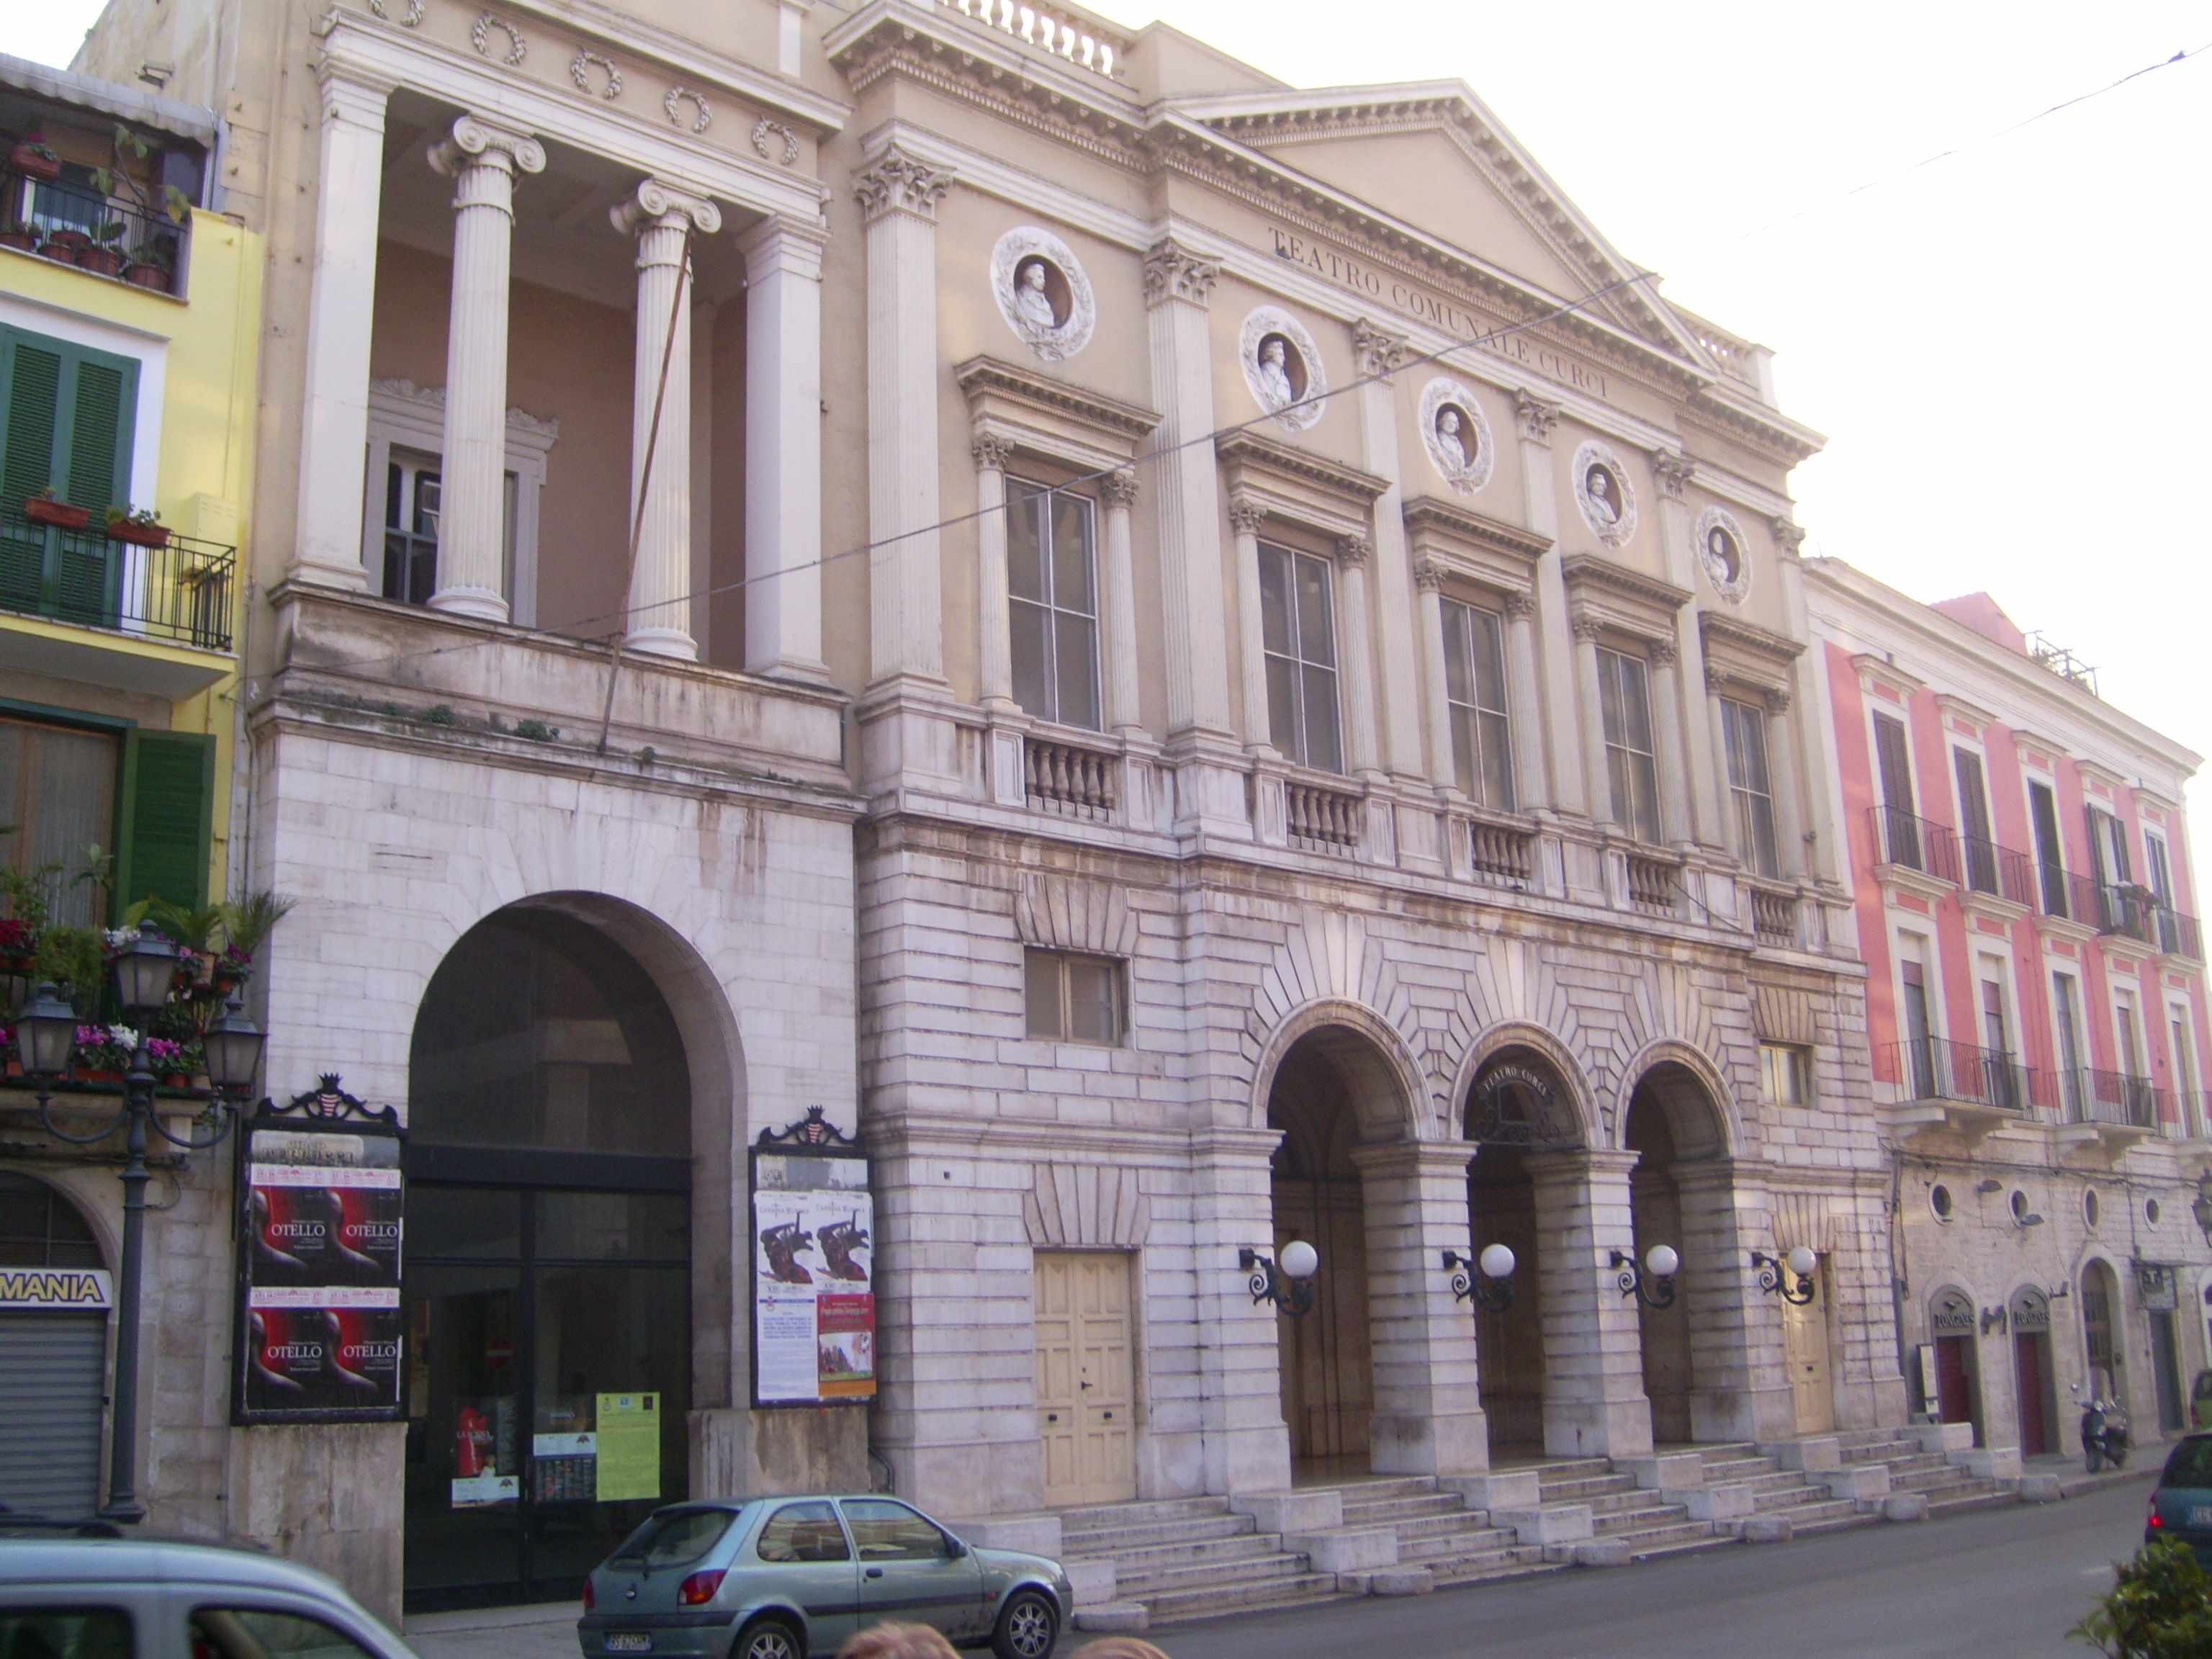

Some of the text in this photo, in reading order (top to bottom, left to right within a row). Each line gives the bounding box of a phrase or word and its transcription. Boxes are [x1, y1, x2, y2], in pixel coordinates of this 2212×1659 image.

[1269, 227, 1610, 399] TEATRO COMUNALE CURCI
[1483, 1066, 1517, 1092] TEATRO
[271, 1223, 325, 1237] OTELLO
[346, 1225, 397, 1238] OTELLO
[0, 1273, 105, 1302] MANIA
[268, 1345, 323, 1359] OTELLO
[343, 1345, 396, 1358] OTELLO
